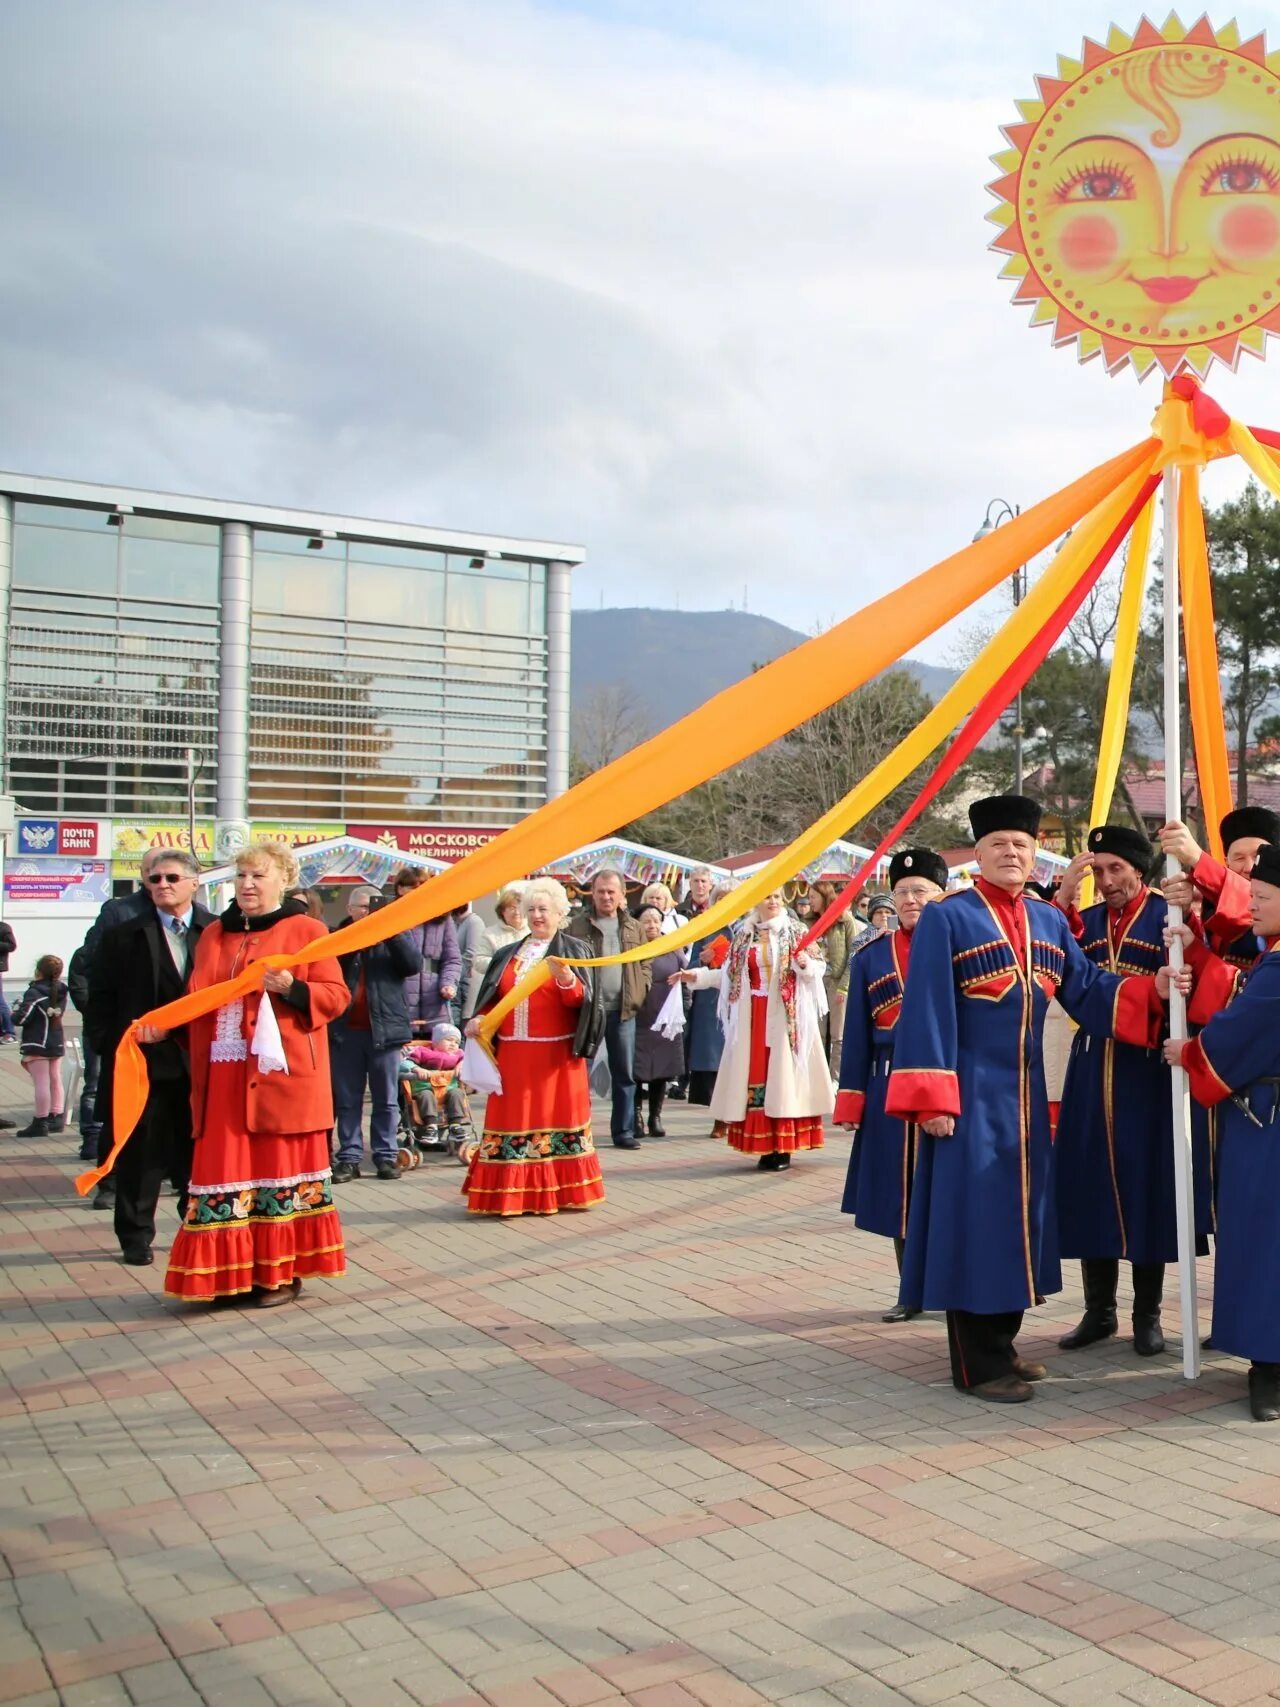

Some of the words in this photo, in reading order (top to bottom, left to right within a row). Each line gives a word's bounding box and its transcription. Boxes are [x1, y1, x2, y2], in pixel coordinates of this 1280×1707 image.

[62, 828, 94, 838] ПОЧТА
[62, 839, 90, 848] БАНК
[409, 847, 480, 857] ЮВЕЛИРНЫ
